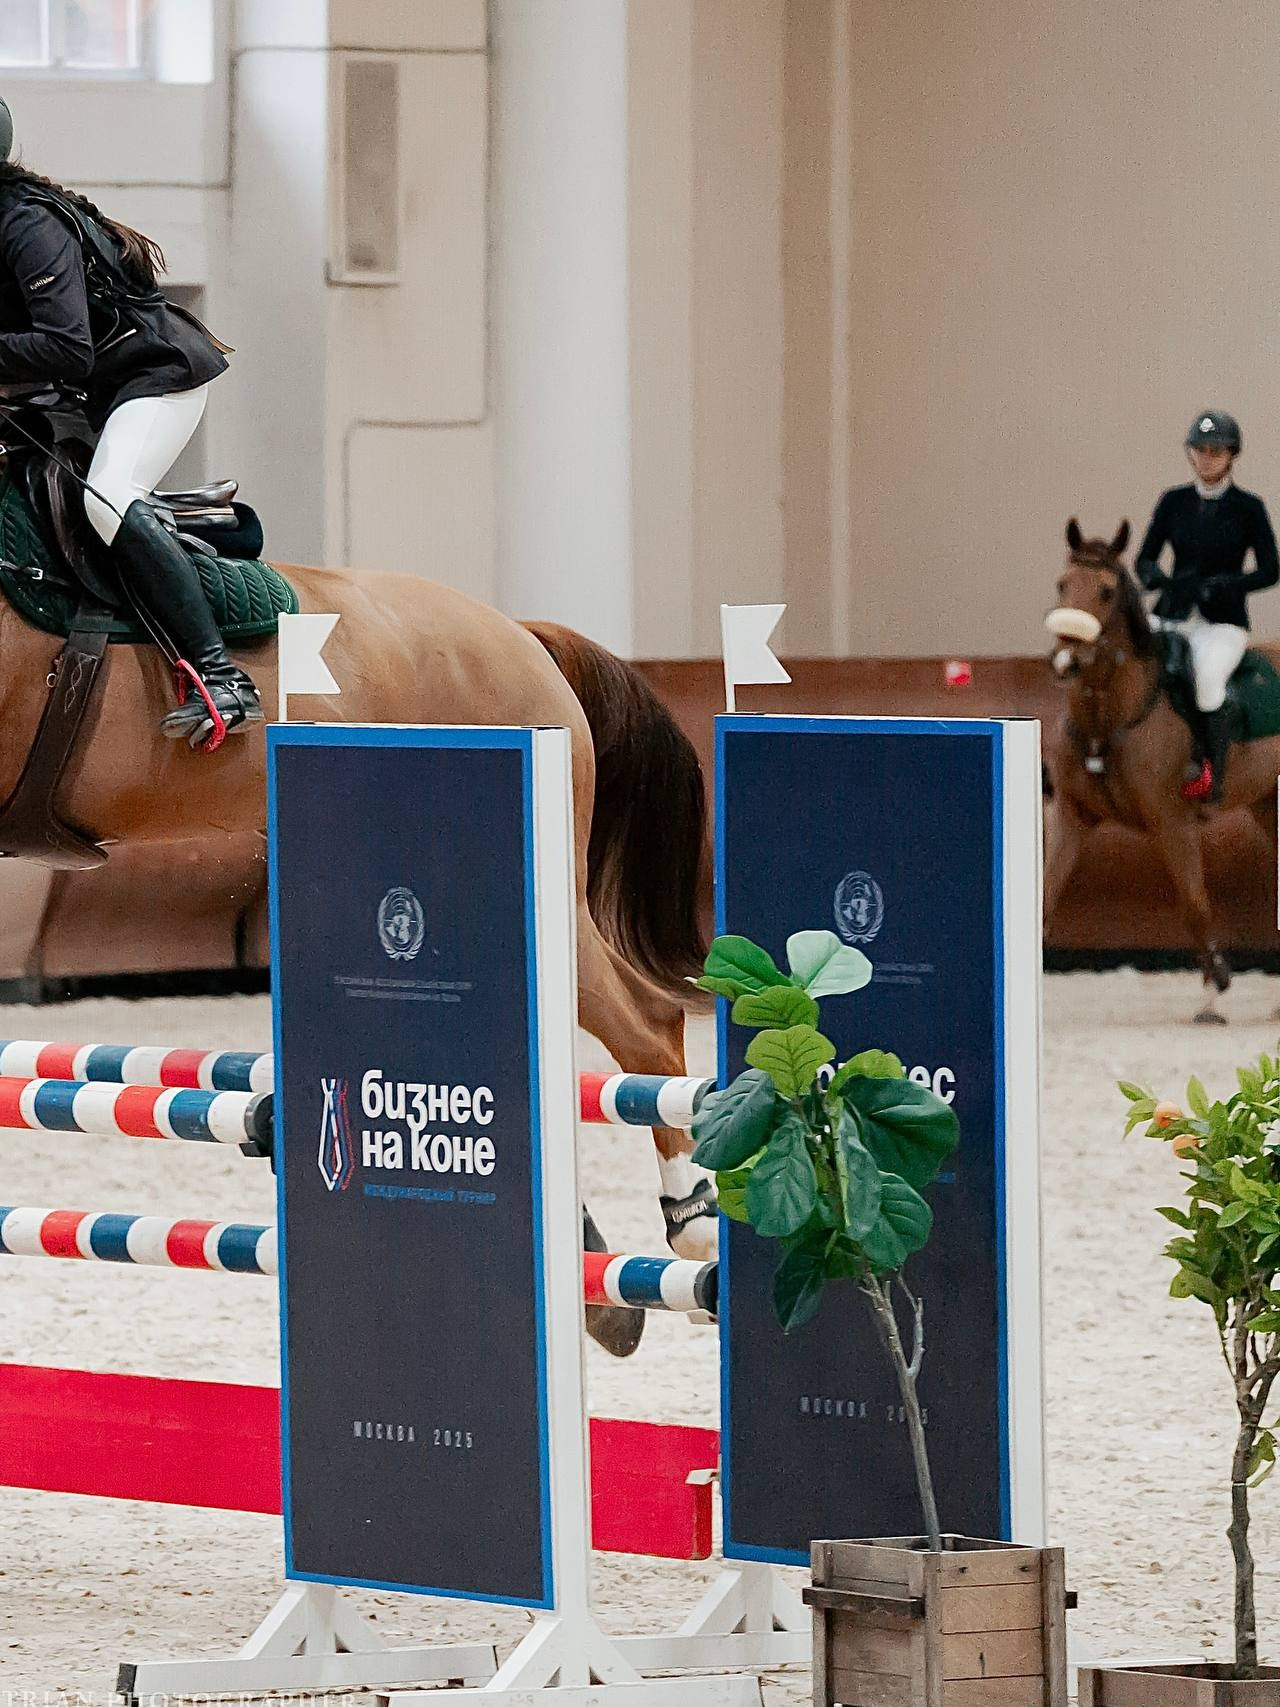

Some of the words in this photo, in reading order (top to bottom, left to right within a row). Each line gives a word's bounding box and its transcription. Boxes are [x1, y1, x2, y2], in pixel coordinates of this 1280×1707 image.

[361, 1069, 495, 1129] бизнес
[362, 1130, 404, 1169] на
[411, 1128, 496, 1176] коне
[353, 1420, 415, 1442] МОСКВА
[433, 1428, 473, 1448] 2025
